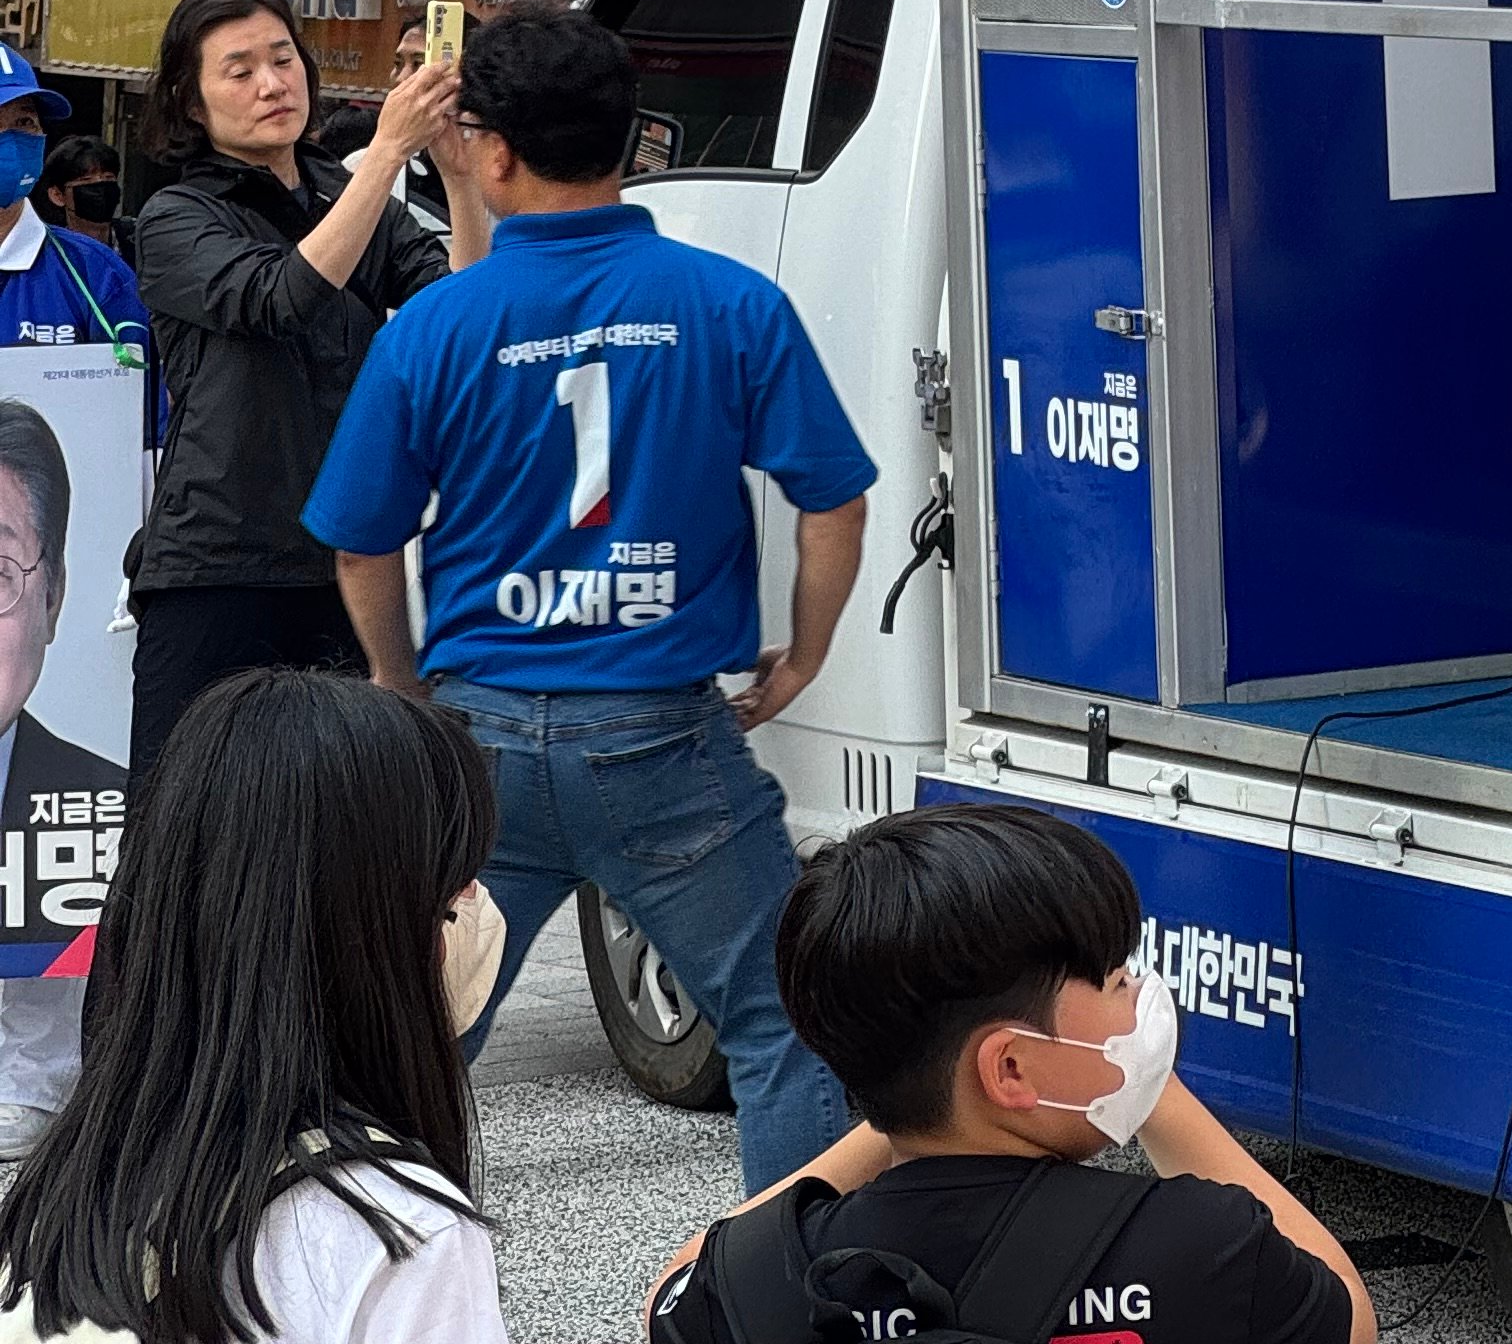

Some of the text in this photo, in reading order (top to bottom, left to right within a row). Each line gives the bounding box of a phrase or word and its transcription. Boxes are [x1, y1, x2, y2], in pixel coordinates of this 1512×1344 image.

[19, 321, 75, 344] 지금은
[497, 336, 571, 367] 이제부터
[605, 323, 679, 346] 대한민국
[1003, 359, 1022, 455] 1
[1103, 372, 1137, 397] 지금은
[556, 362, 611, 529] 1
[1047, 395, 1140, 472] 이재명
[608, 542, 676, 565] 지금은
[496, 568, 675, 628] 이재명
[30, 790, 125, 824] 지금은
[1163, 926, 1304, 1037] 대한민국
